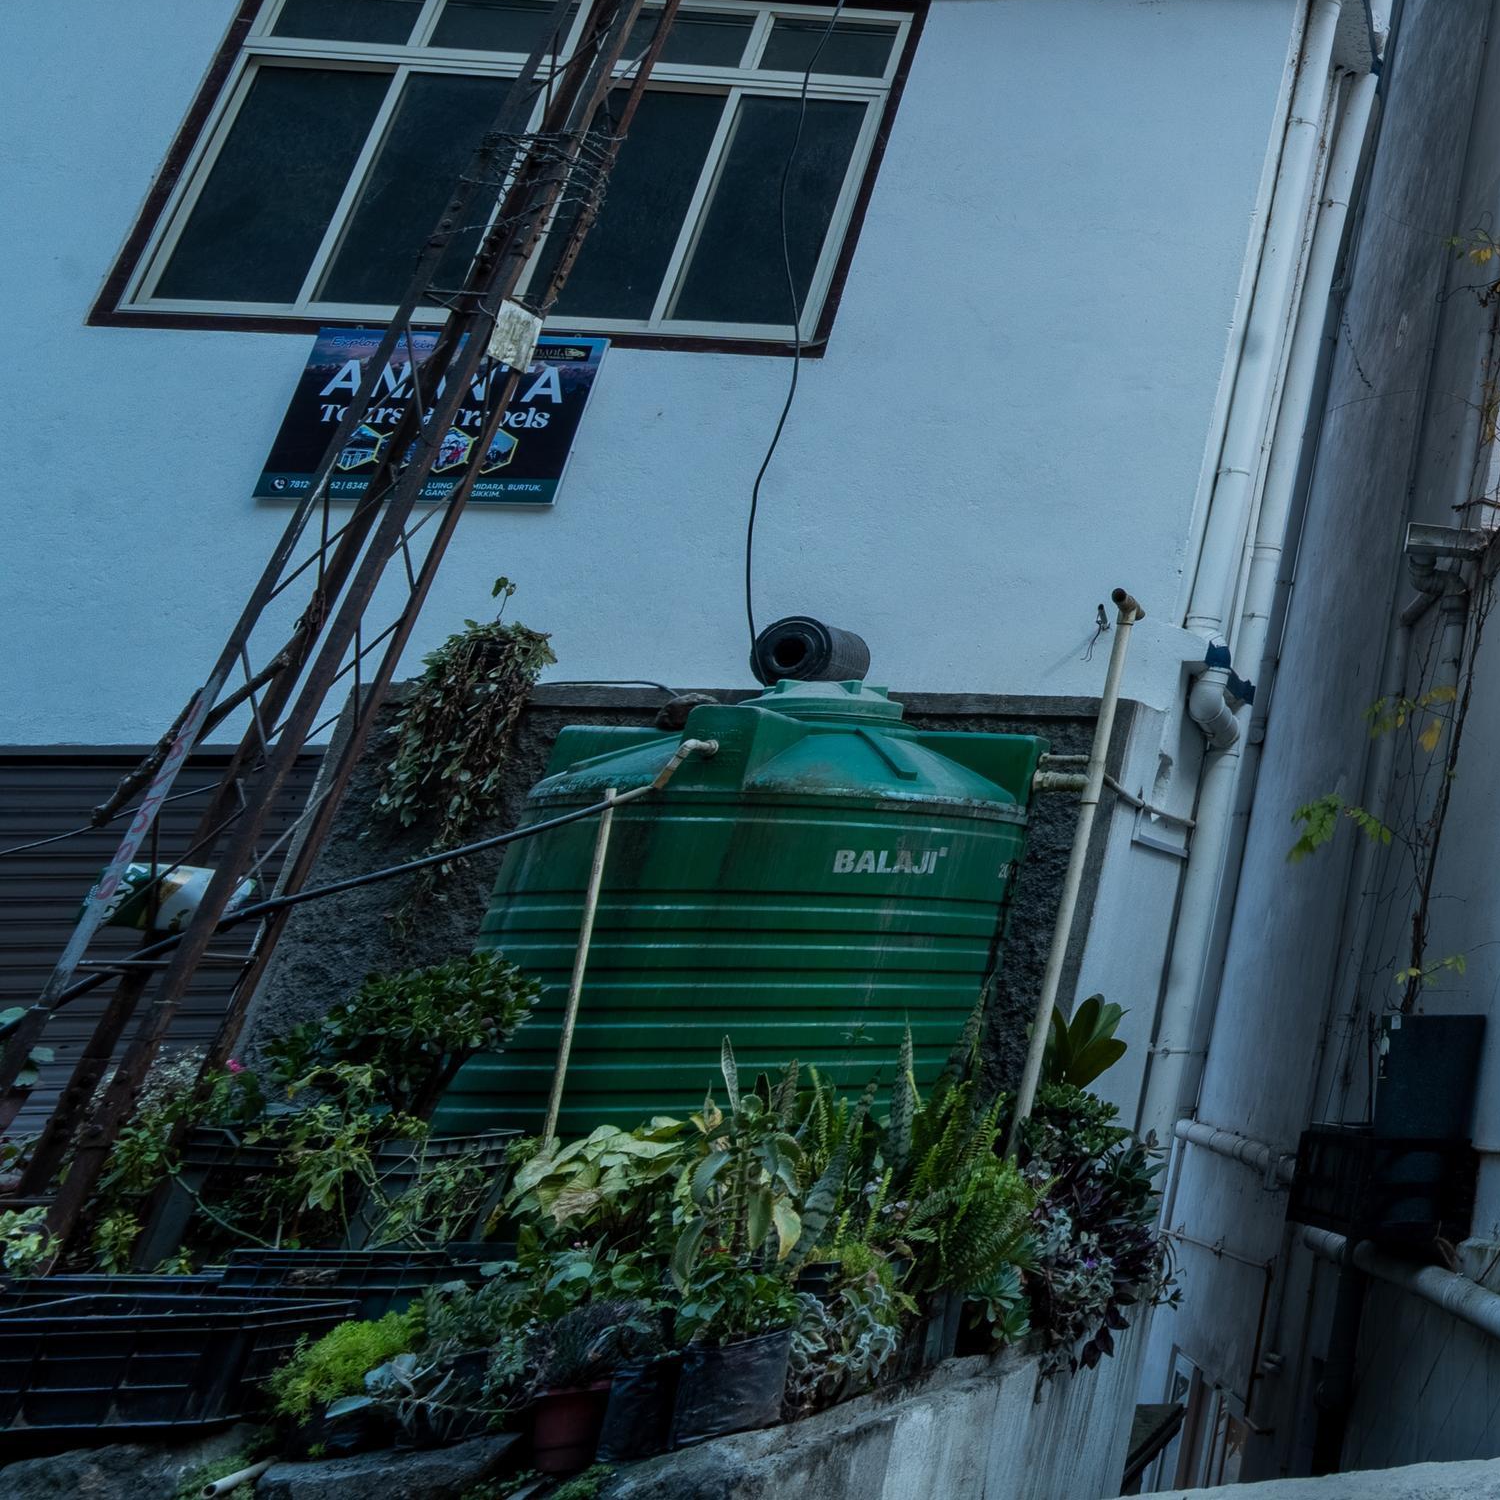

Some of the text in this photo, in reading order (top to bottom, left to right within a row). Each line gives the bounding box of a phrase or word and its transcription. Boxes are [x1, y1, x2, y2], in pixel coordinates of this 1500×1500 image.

[330, 336, 381, 349] Explor
[319, 359, 563, 403] ANNA
[833, 849, 938, 875] BALAJI
